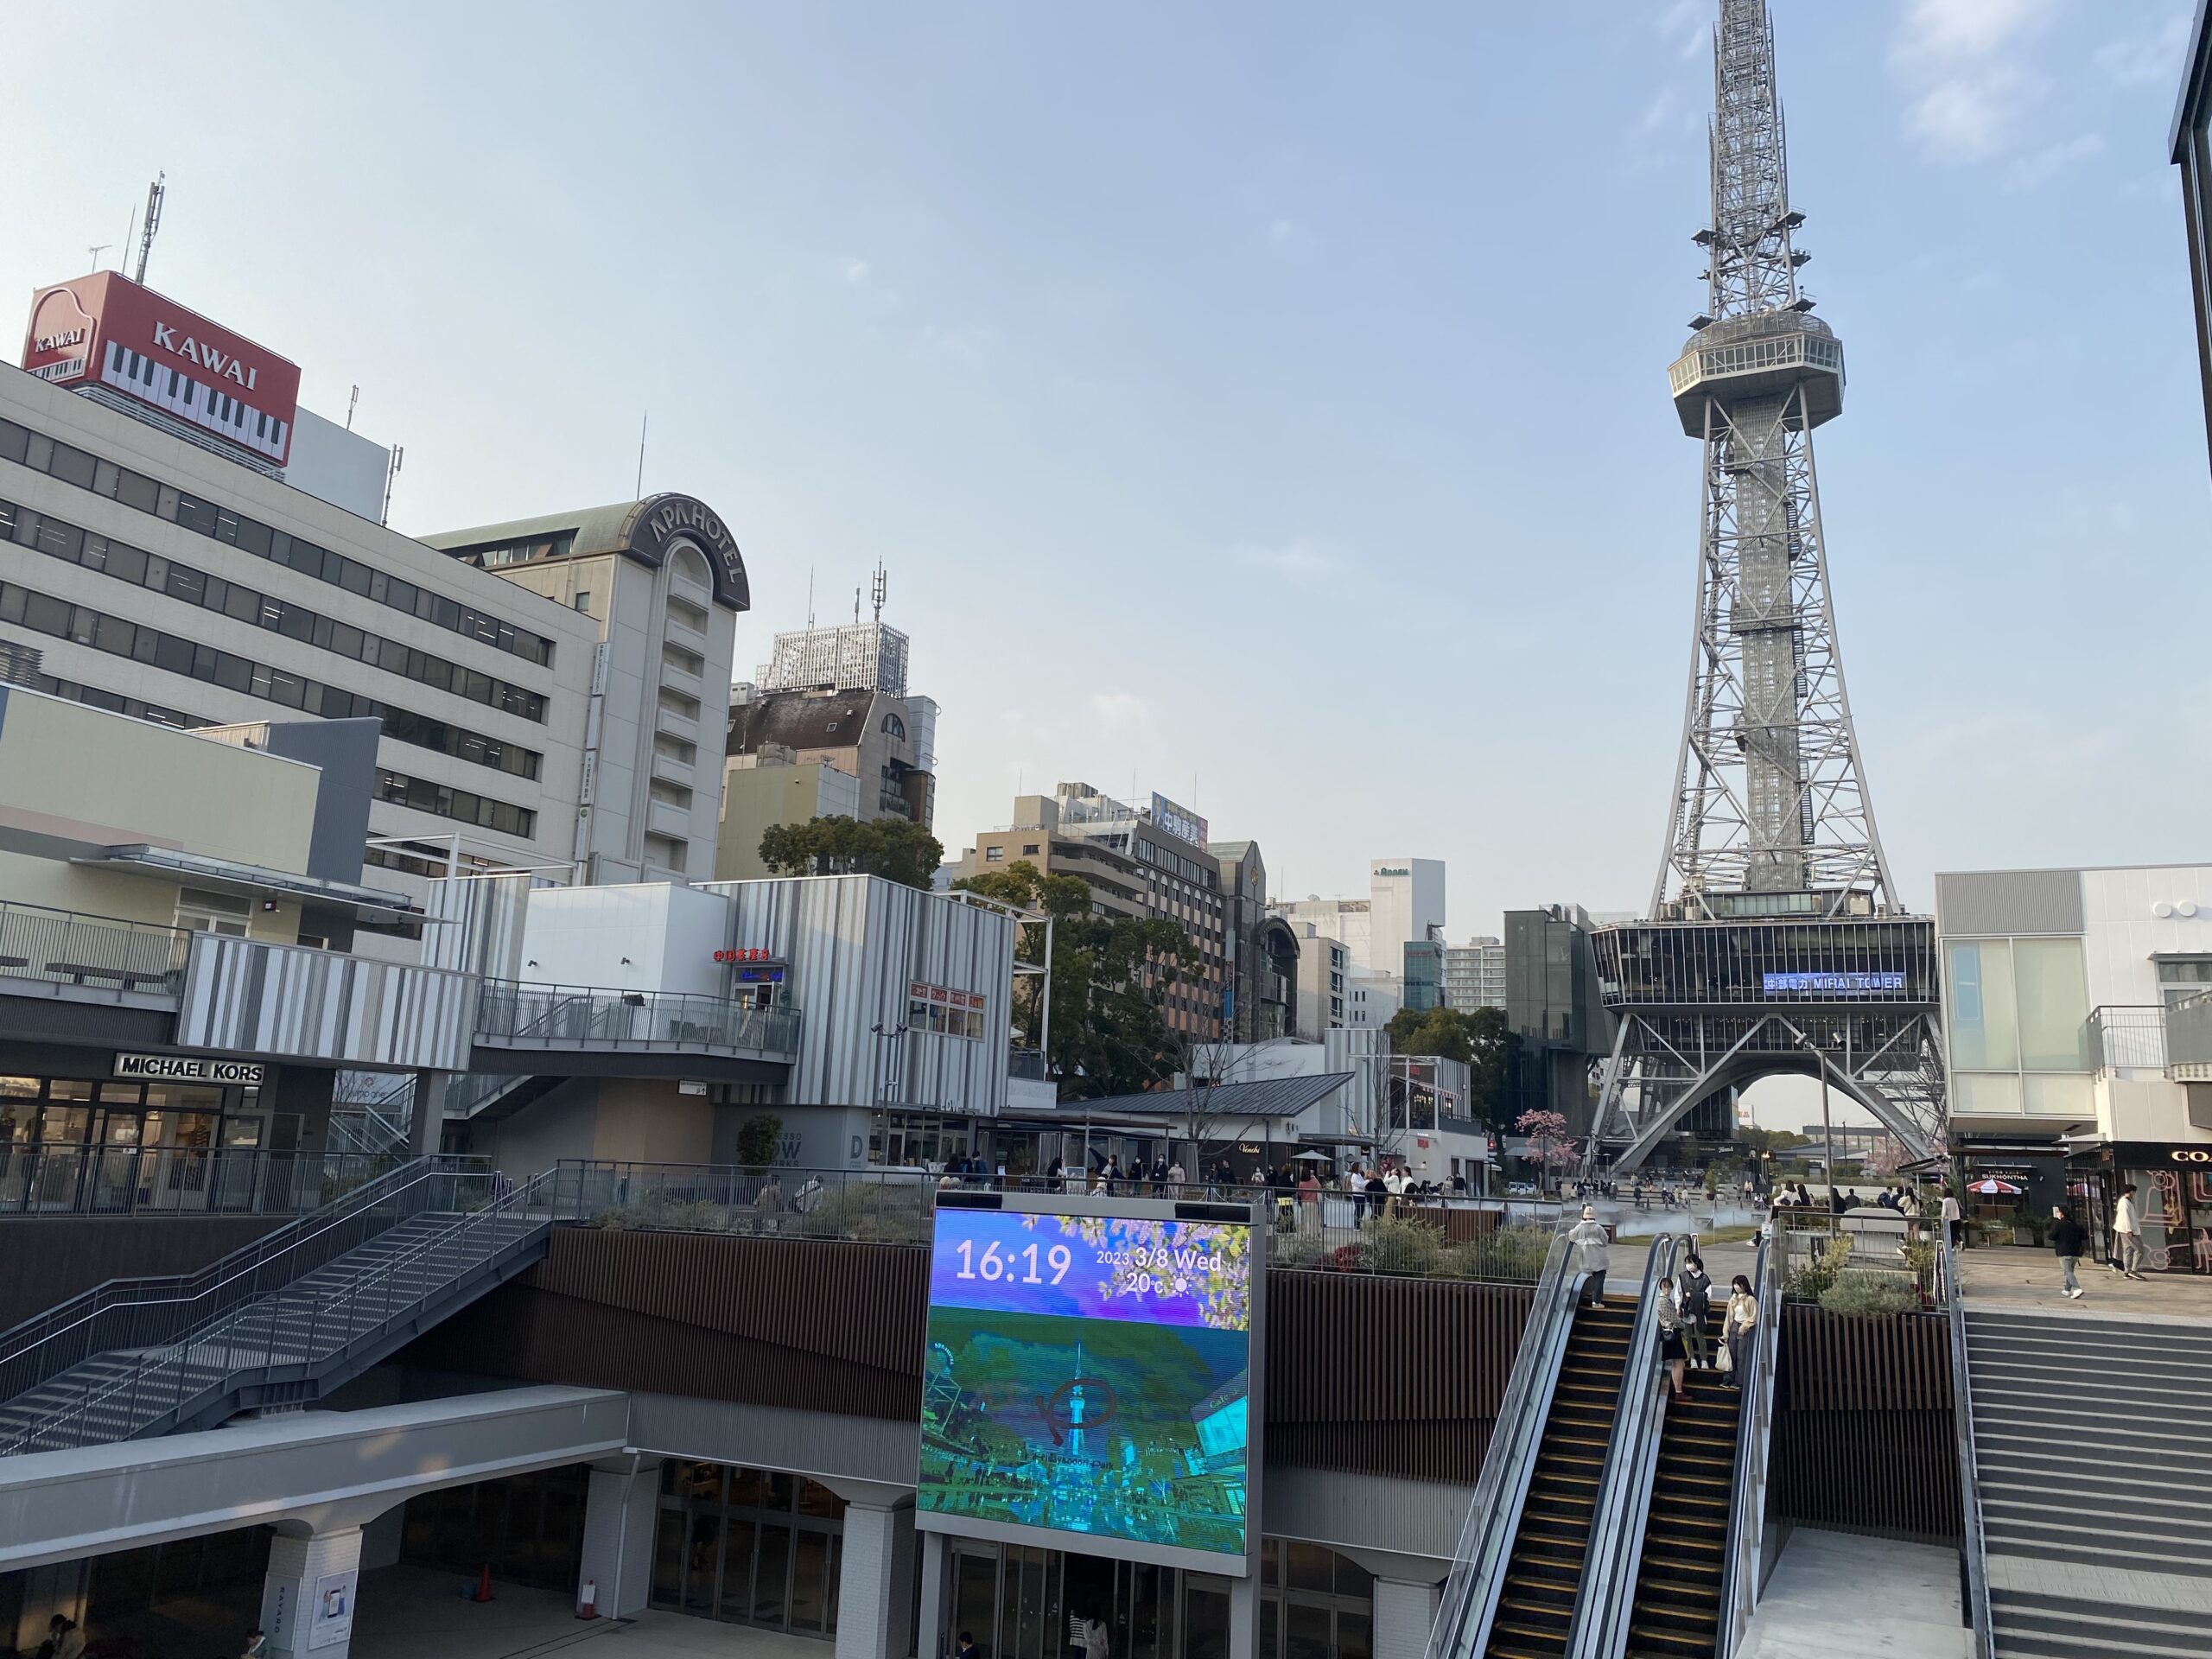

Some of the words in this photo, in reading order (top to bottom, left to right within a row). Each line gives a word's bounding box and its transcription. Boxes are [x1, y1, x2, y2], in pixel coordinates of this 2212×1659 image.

[35, 327, 86, 353] KAWAI
[154, 321, 257, 391] KAWAI
[650, 503, 690, 543] APA
[691, 505, 742, 584] HOTEL
[1765, 978, 1808, 990] 中部電力
[1814, 977, 1850, 989] MIRAI
[1855, 977, 1902, 988] TOWER
[122, 1058, 207, 1077] MICHAEL
[213, 1064, 262, 1082] KORS
[849, 1135, 863, 1159] D
[1239, 1142, 1260, 1154] Venchi
[2171, 1150, 2212, 1162] CO
[956, 1239, 1071, 1285] 16:19
[1096, 1251, 1129, 1265] 2023
[1135, 1247, 1168, 1268] 3/8
[1173, 1249, 1222, 1272] Wed
